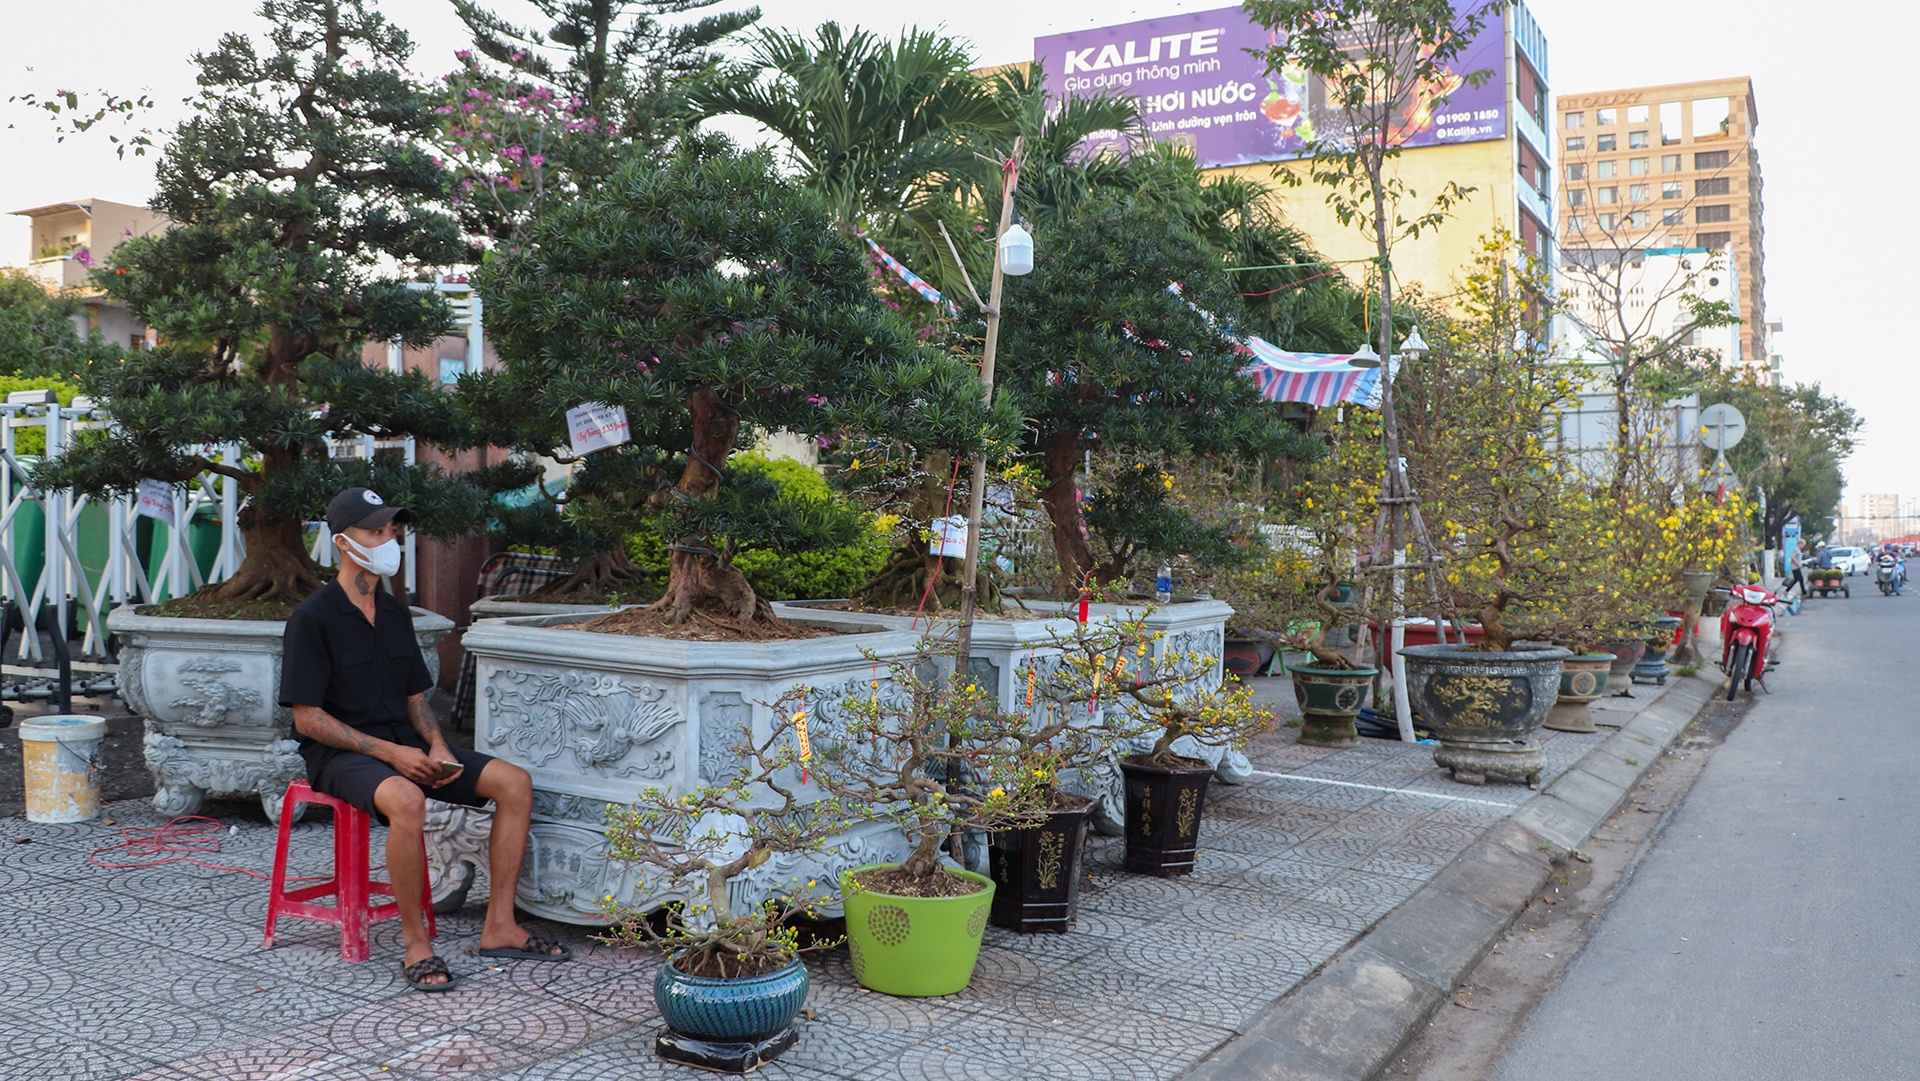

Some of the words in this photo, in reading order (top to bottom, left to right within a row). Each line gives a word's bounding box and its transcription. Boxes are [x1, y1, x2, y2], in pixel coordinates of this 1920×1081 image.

[1064, 28, 1219, 74] KALITE
[1064, 76, 1090, 92] Gia
[1094, 71, 1132, 89] dụng
[1136, 64, 1180, 80] thông
[1184, 58, 1220, 75] minh
[1147, 90, 1185, 114] HƠI
[1191, 80, 1257, 108] NƯỚC
[1582, 93, 1642, 108] GALAXY
[1177, 115, 1211, 129] dưỡng
[1213, 113, 1233, 127] vẹn
[1235, 109, 1257, 121] tròn
[1446, 112, 1471, 124] 1900
[1473, 109, 1499, 120] 1850
[1447, 126, 1492, 137] Kalite.vn
